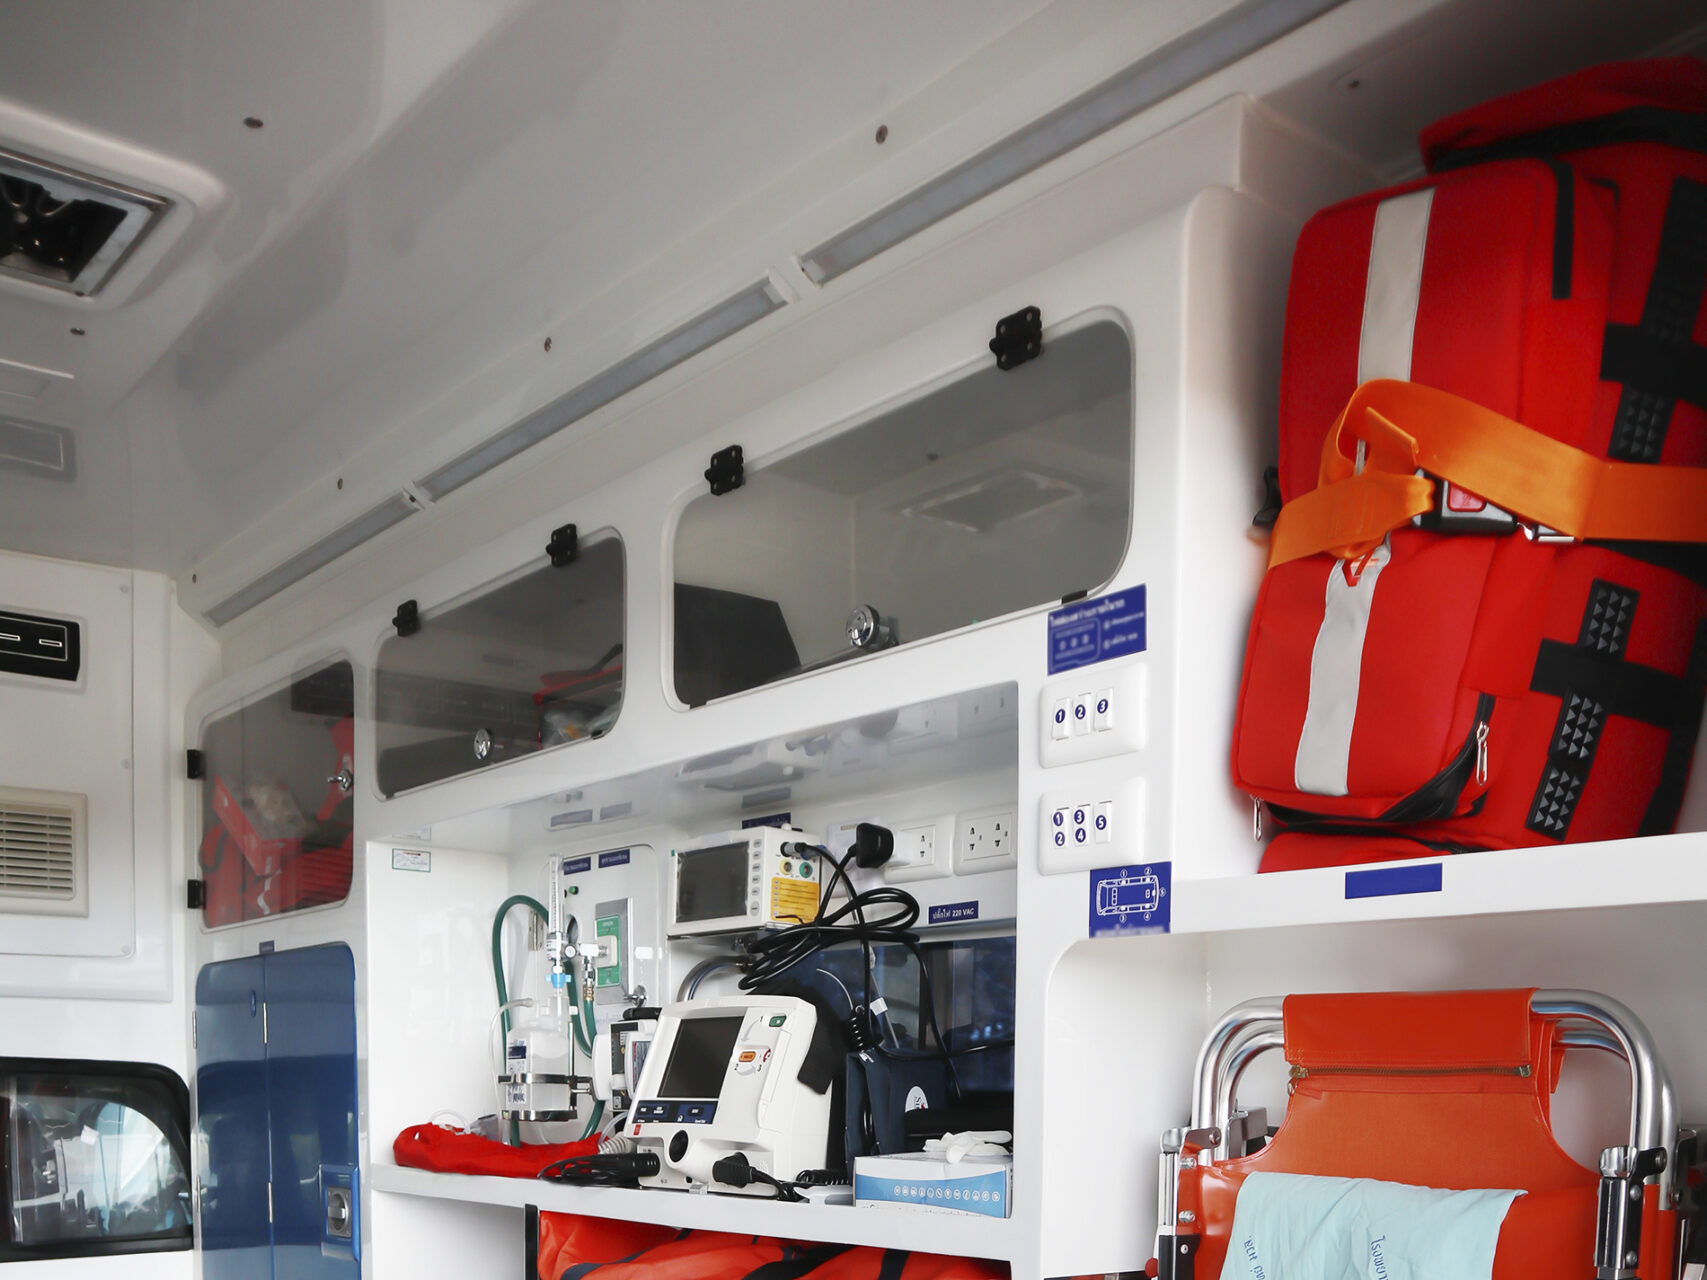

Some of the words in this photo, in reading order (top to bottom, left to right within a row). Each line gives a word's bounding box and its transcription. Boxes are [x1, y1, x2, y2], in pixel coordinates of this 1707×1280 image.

[1056, 710, 1065, 722] 1
[1076, 706, 1085, 719] 2
[1098, 700, 1107, 713] 3
[1054, 813, 1062, 825] 1
[1075, 810, 1084, 823] 3
[1097, 816, 1106, 829] 5
[1056, 833, 1064, 845] 2
[1076, 829, 1085, 842] 4
[952, 909, 962, 917] 220
[963, 907, 975, 916] VAC
